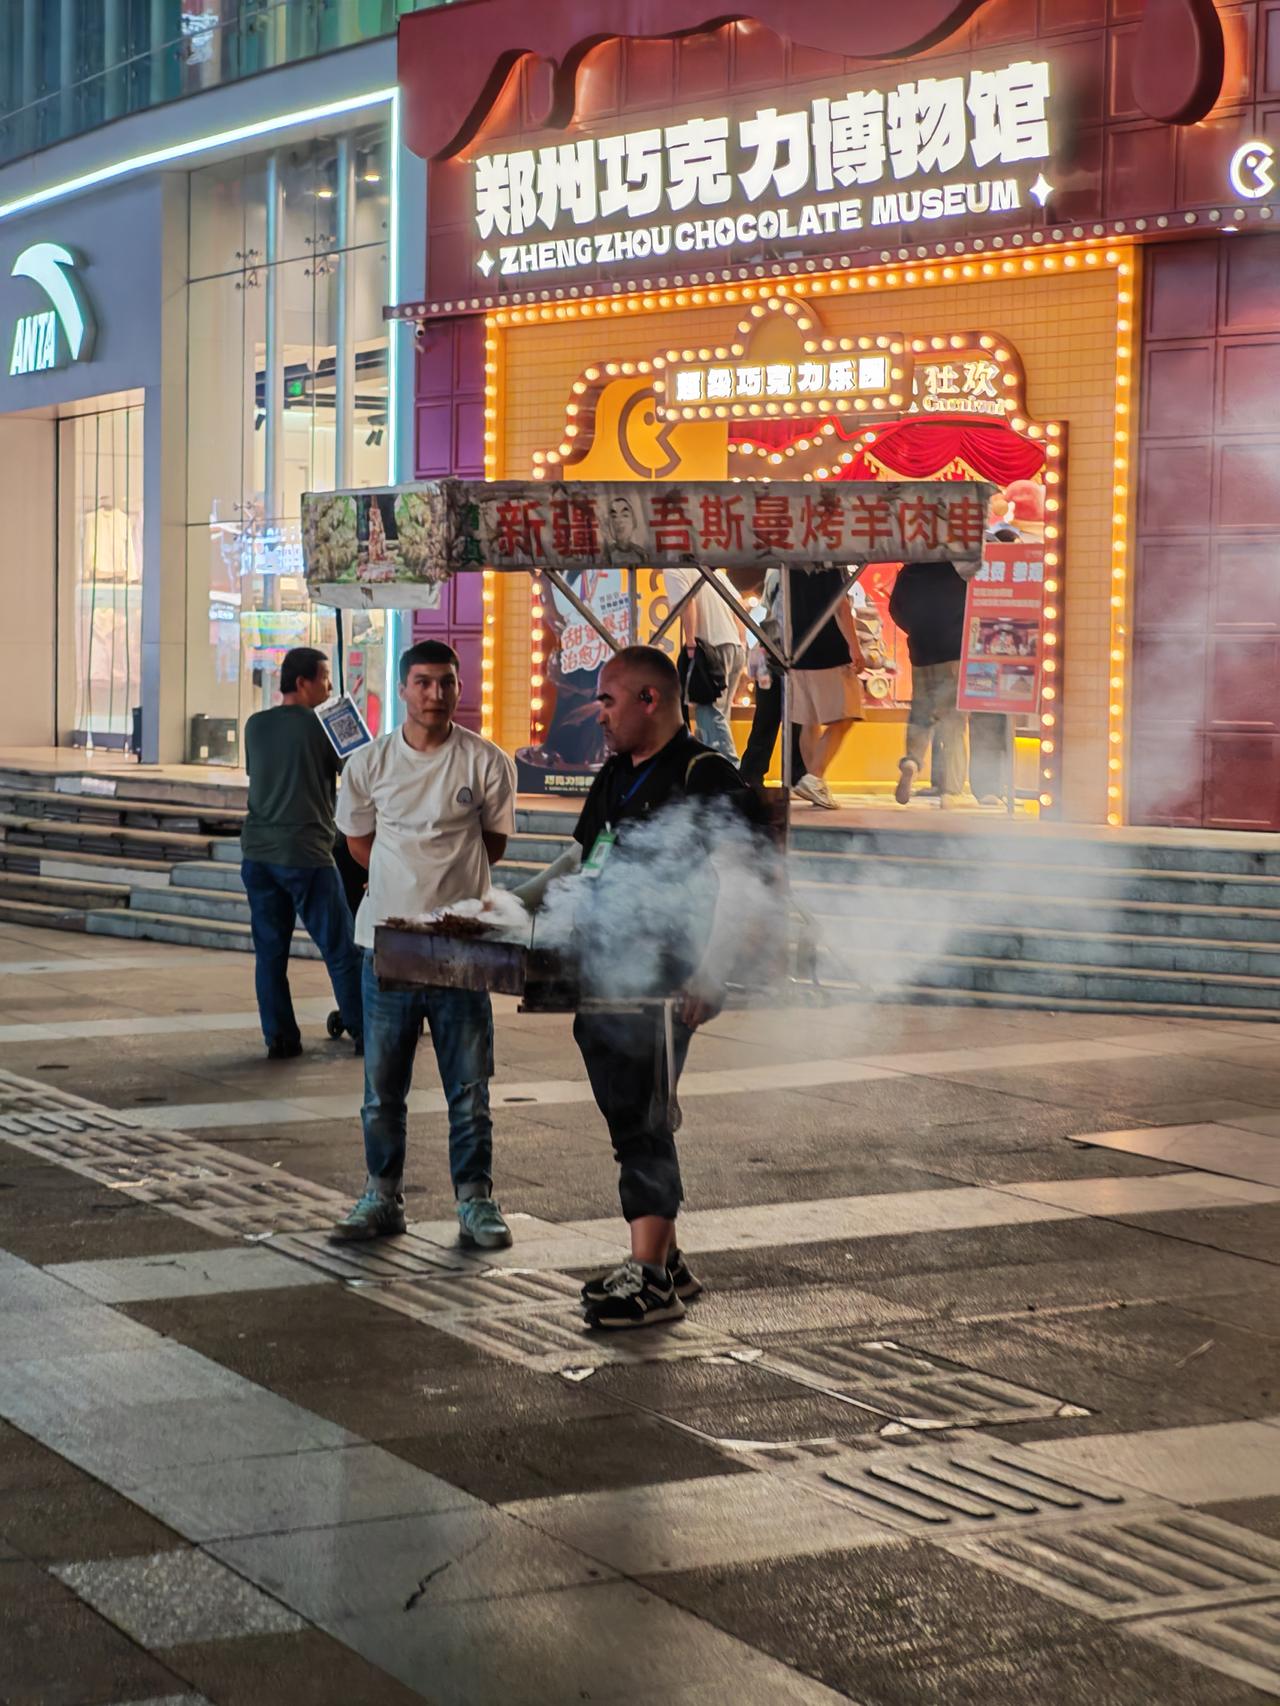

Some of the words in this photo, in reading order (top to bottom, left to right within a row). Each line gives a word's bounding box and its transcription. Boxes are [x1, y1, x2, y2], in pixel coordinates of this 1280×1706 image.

[475, 61, 1051, 239] 郑州巧克力博物馆
[674, 198, 862, 252] CHOCOLATE
[870, 179, 1022, 227] MUSEUM
[9, 310, 56, 376] ANTA
[496, 497, 600, 560] 新疆
[649, 494, 984, 553] 吾斯曼烤羊肉串
